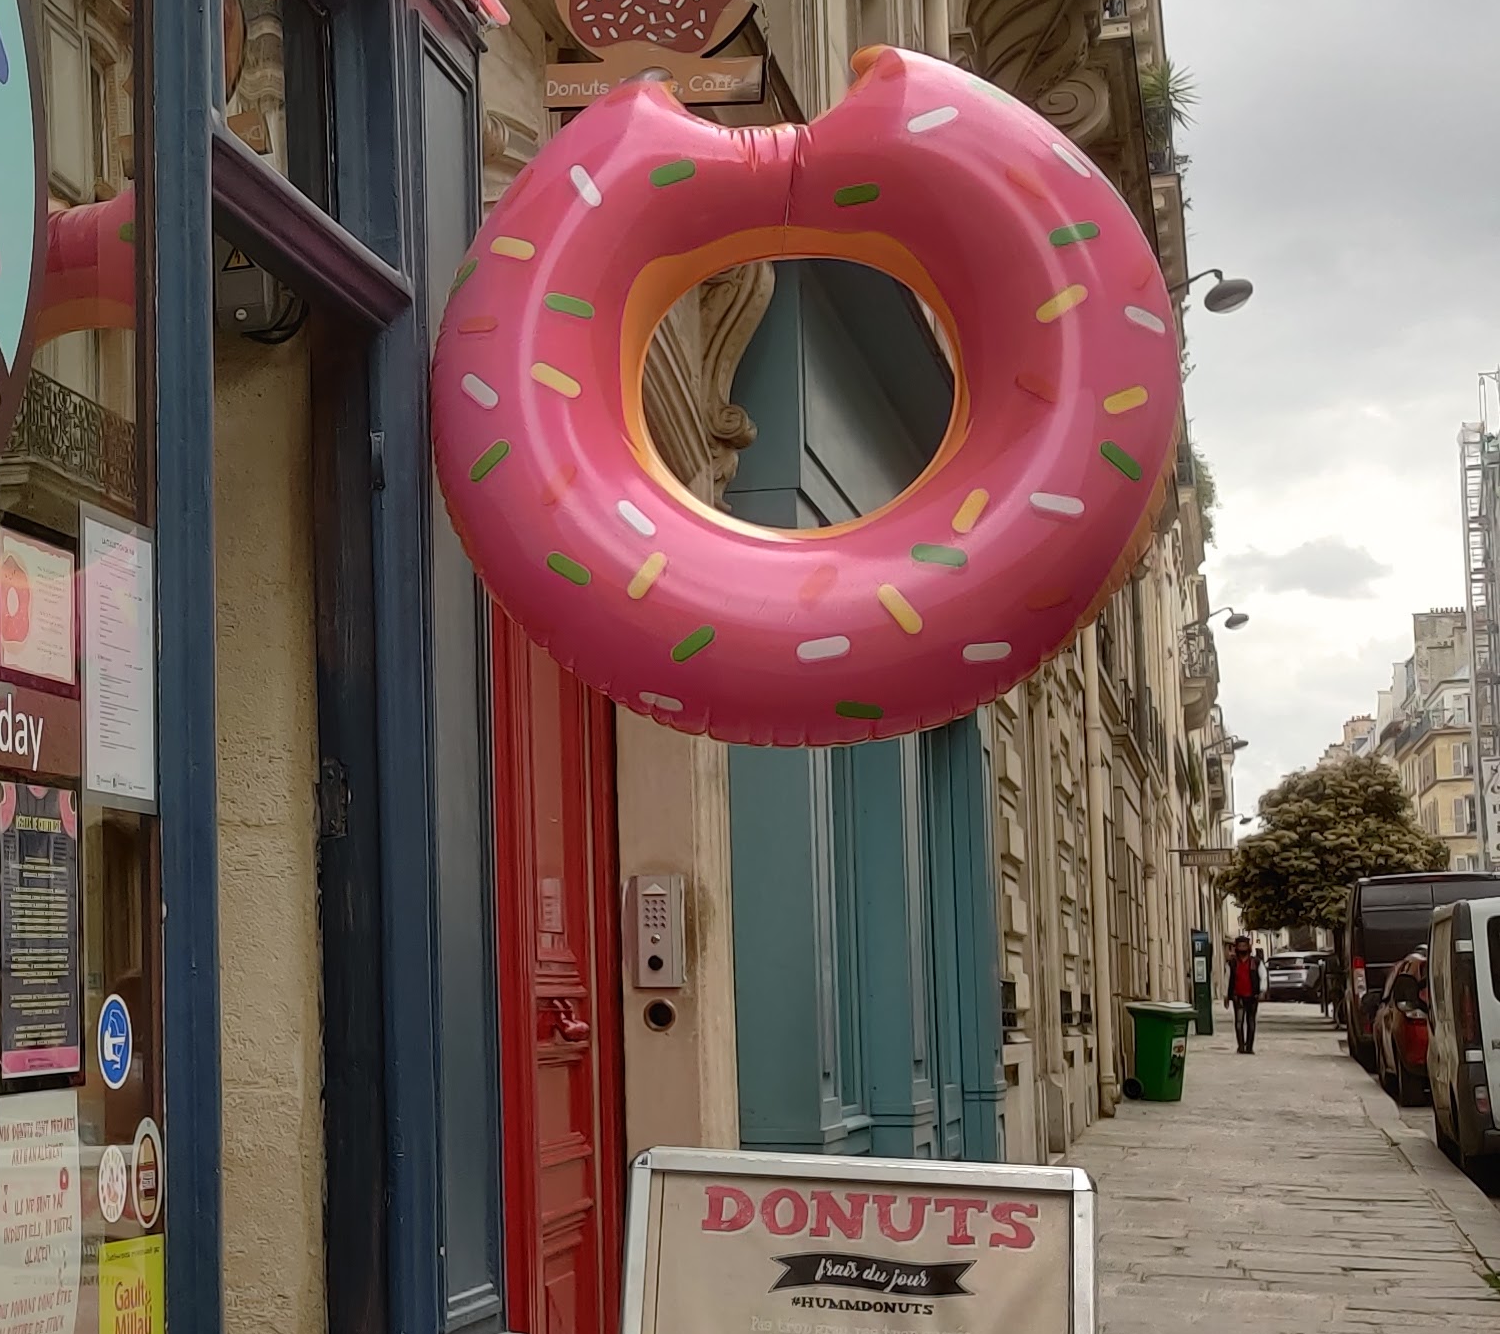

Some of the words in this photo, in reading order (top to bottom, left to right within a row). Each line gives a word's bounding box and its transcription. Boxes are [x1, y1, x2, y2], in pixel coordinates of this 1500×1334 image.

[701, 1185, 1039, 1250] DONUTS
[815, 1258, 860, 1281] frais
[862, 1262, 888, 1283] du
[883, 1269, 931, 1293] jour
[791, 1296, 935, 1316] #HUMMDONUTS
